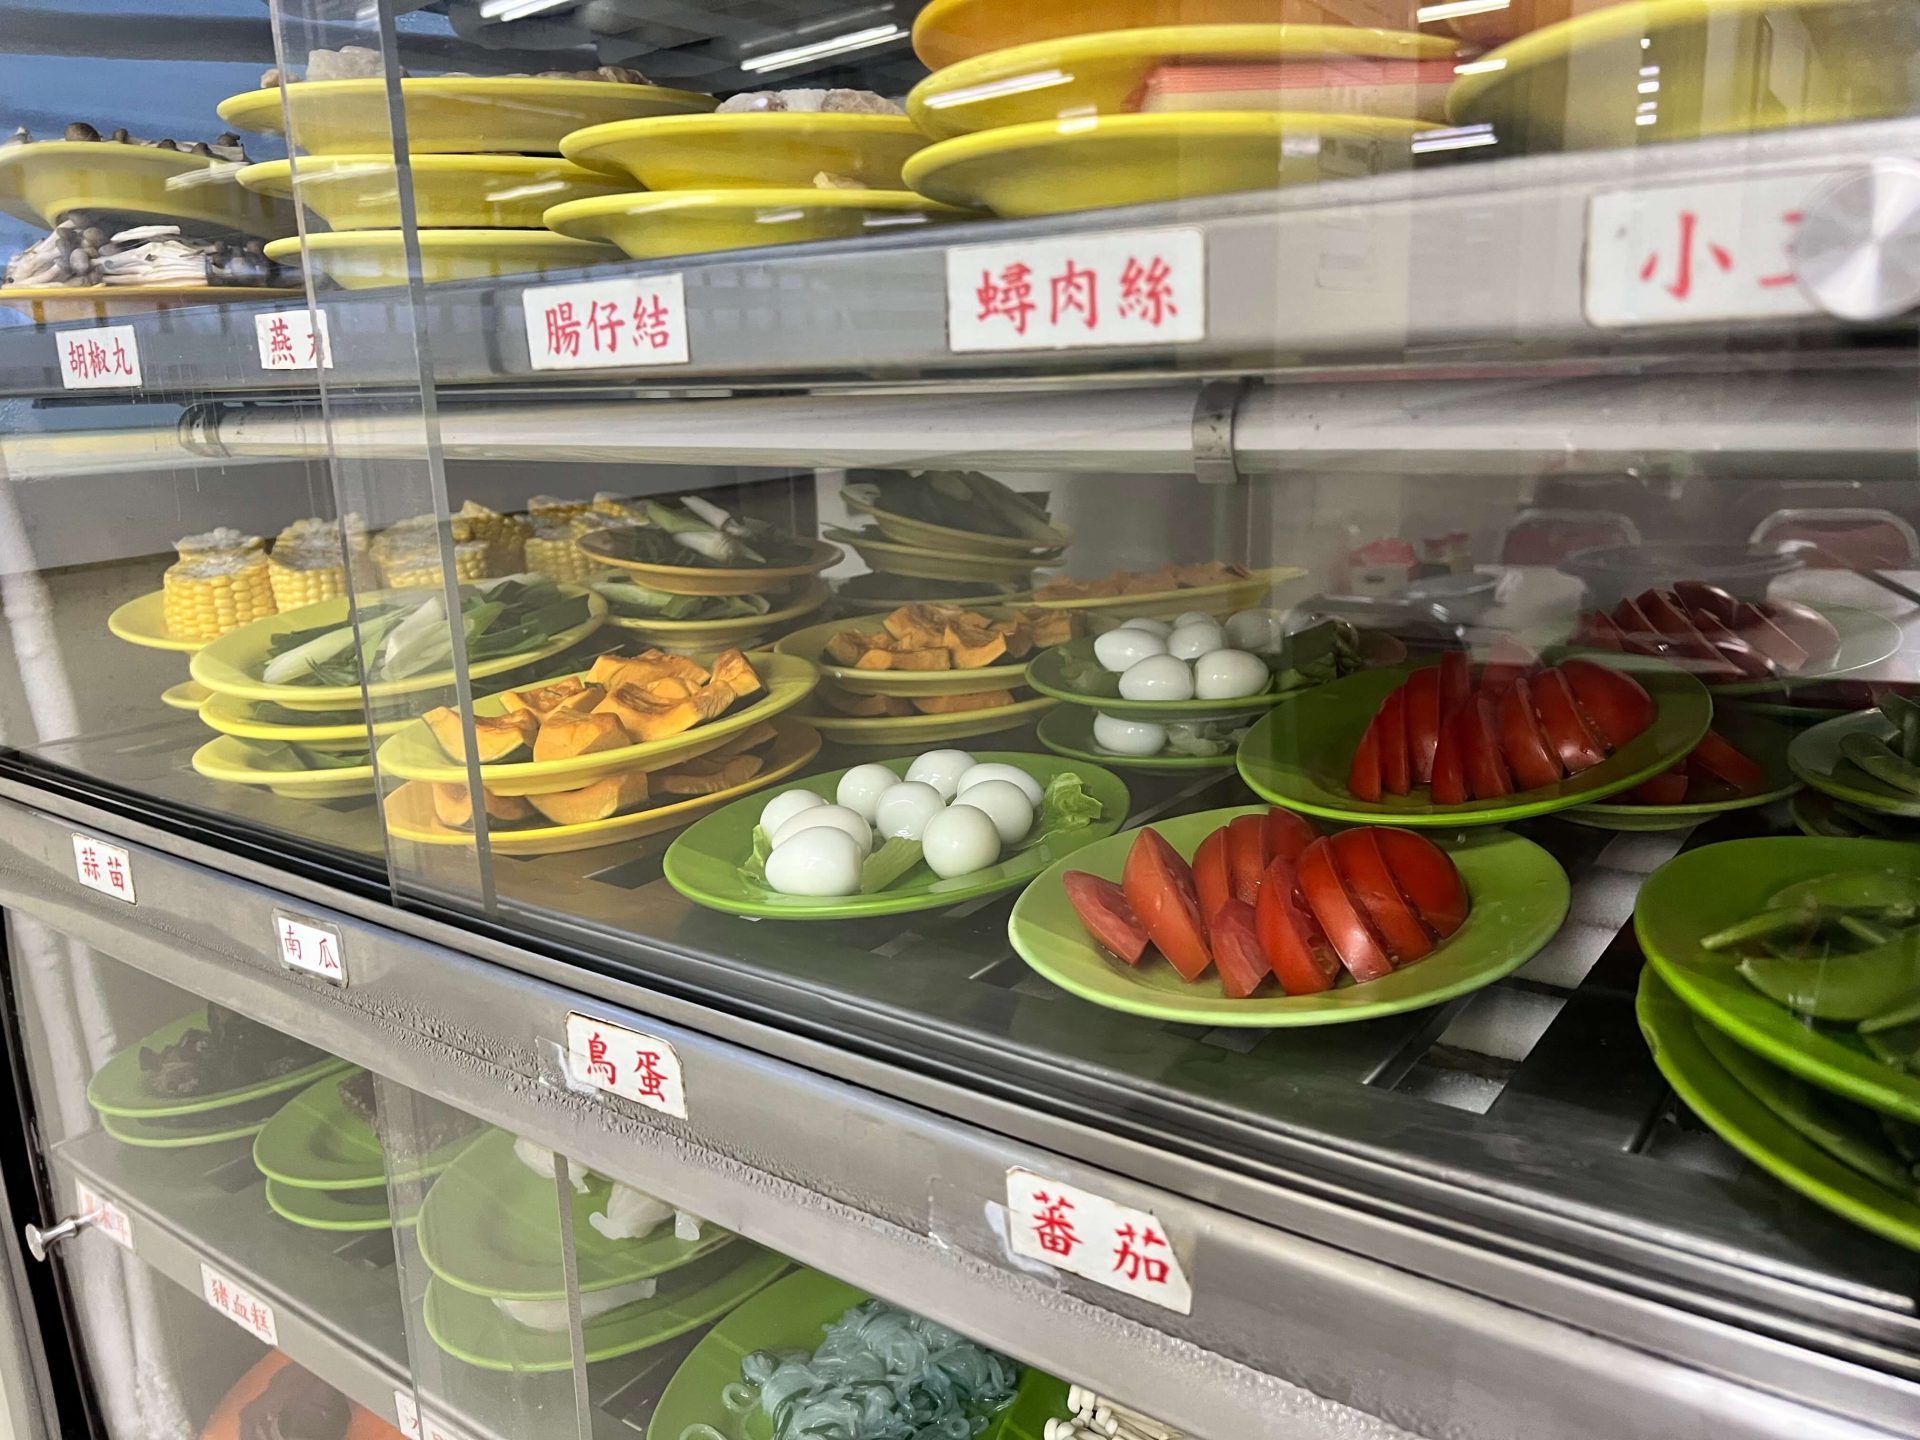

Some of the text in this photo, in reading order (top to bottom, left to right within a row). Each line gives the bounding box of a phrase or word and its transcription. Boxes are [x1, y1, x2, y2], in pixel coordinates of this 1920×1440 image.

[545, 294, 669, 357] 腸仔結
[975, 255, 1178, 335] 蟳肉絲
[68, 337, 133, 379] 胡椒丸
[81, 847, 125, 892] 蒜苗
[284, 924, 338, 969] 南瓜
[586, 1031, 669, 1102] 鳥蛋
[1031, 1190, 1170, 1284] 蕃茄
